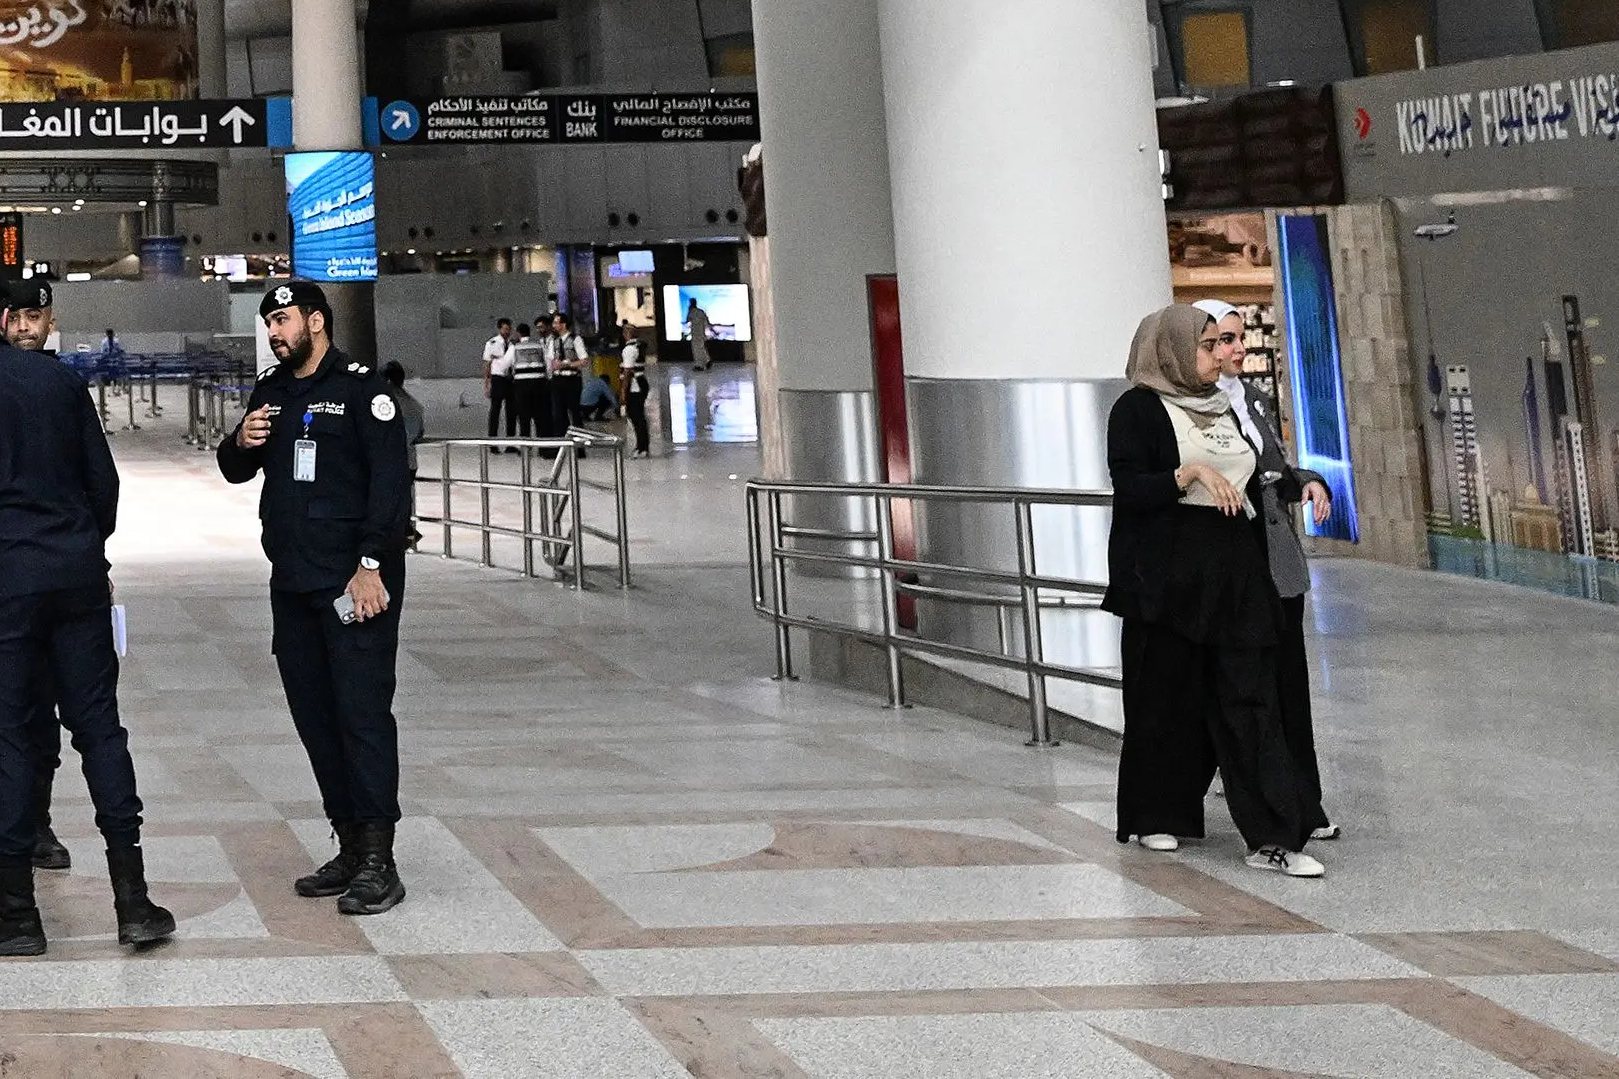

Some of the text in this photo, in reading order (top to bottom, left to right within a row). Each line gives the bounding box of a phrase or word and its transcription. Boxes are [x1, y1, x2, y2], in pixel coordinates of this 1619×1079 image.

[566, 100, 597, 121] بنك
[89, 107, 208, 145] بوابات
[427, 116, 547, 127] CRIMINAL SENTENCES
[613, 114, 754, 127] FINANCIAL DISCLOSURE
[1396, 93, 1473, 154] KUWAIT
[427, 128, 550, 140] ENFORCEMENT OFFICE
[565, 122, 598, 138] BANK
[661, 127, 704, 139] OFFICE
